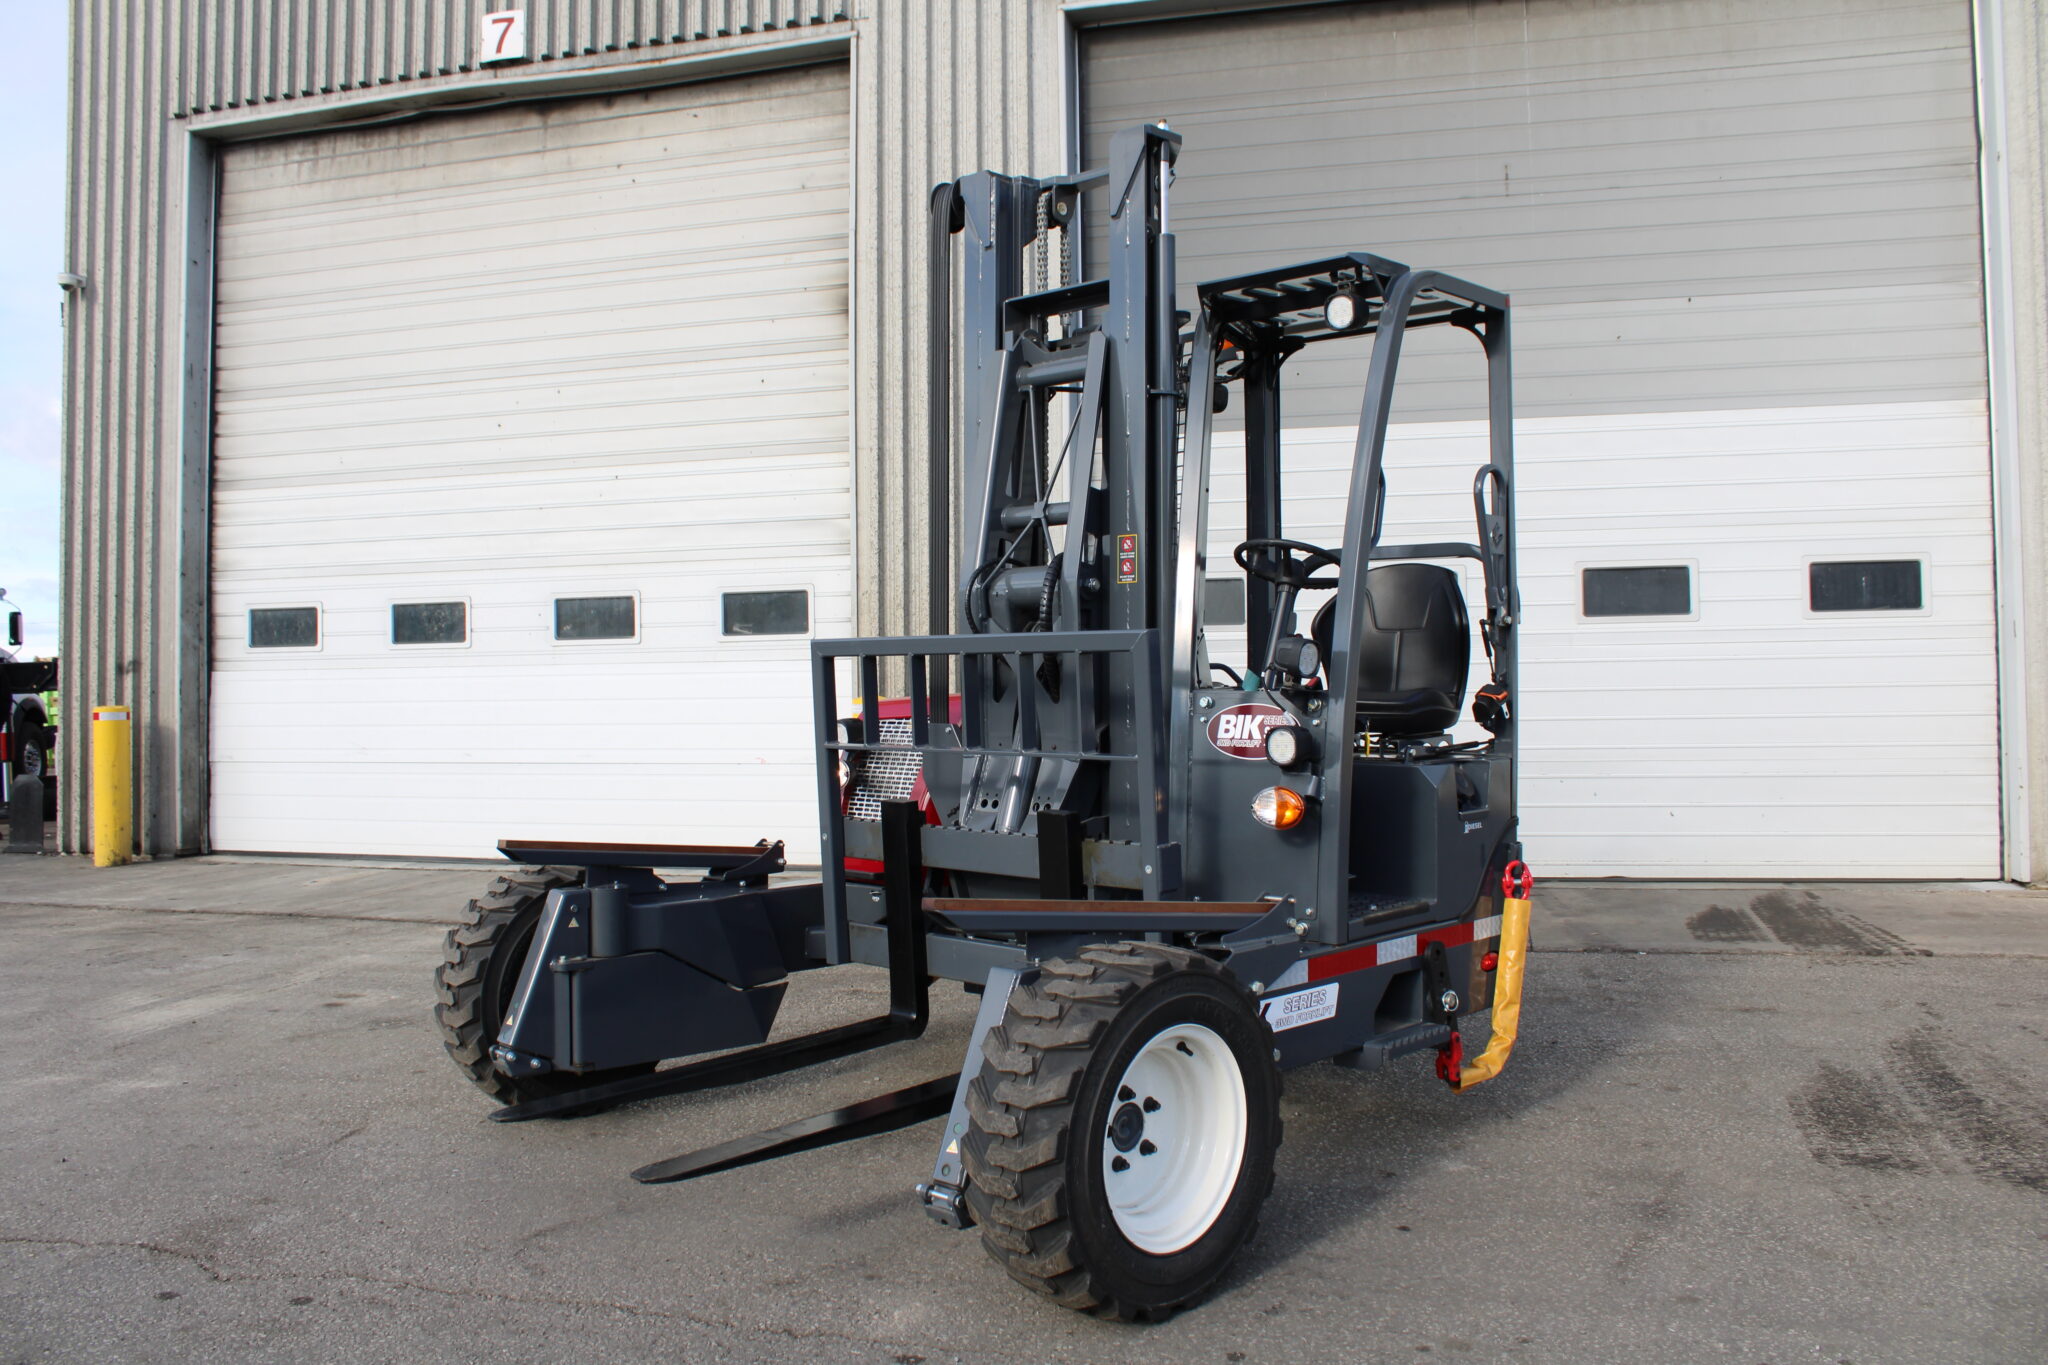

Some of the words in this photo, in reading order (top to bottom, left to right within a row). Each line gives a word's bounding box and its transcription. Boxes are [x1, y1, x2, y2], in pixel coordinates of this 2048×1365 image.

[491, 16, 515, 55] 7
[1217, 714, 1265, 739] BIK
[1263, 715, 1292, 725] SERIE
[1283, 990, 1327, 1014] SERIES
[1295, 1004, 1335, 1023] FORKLIFT
